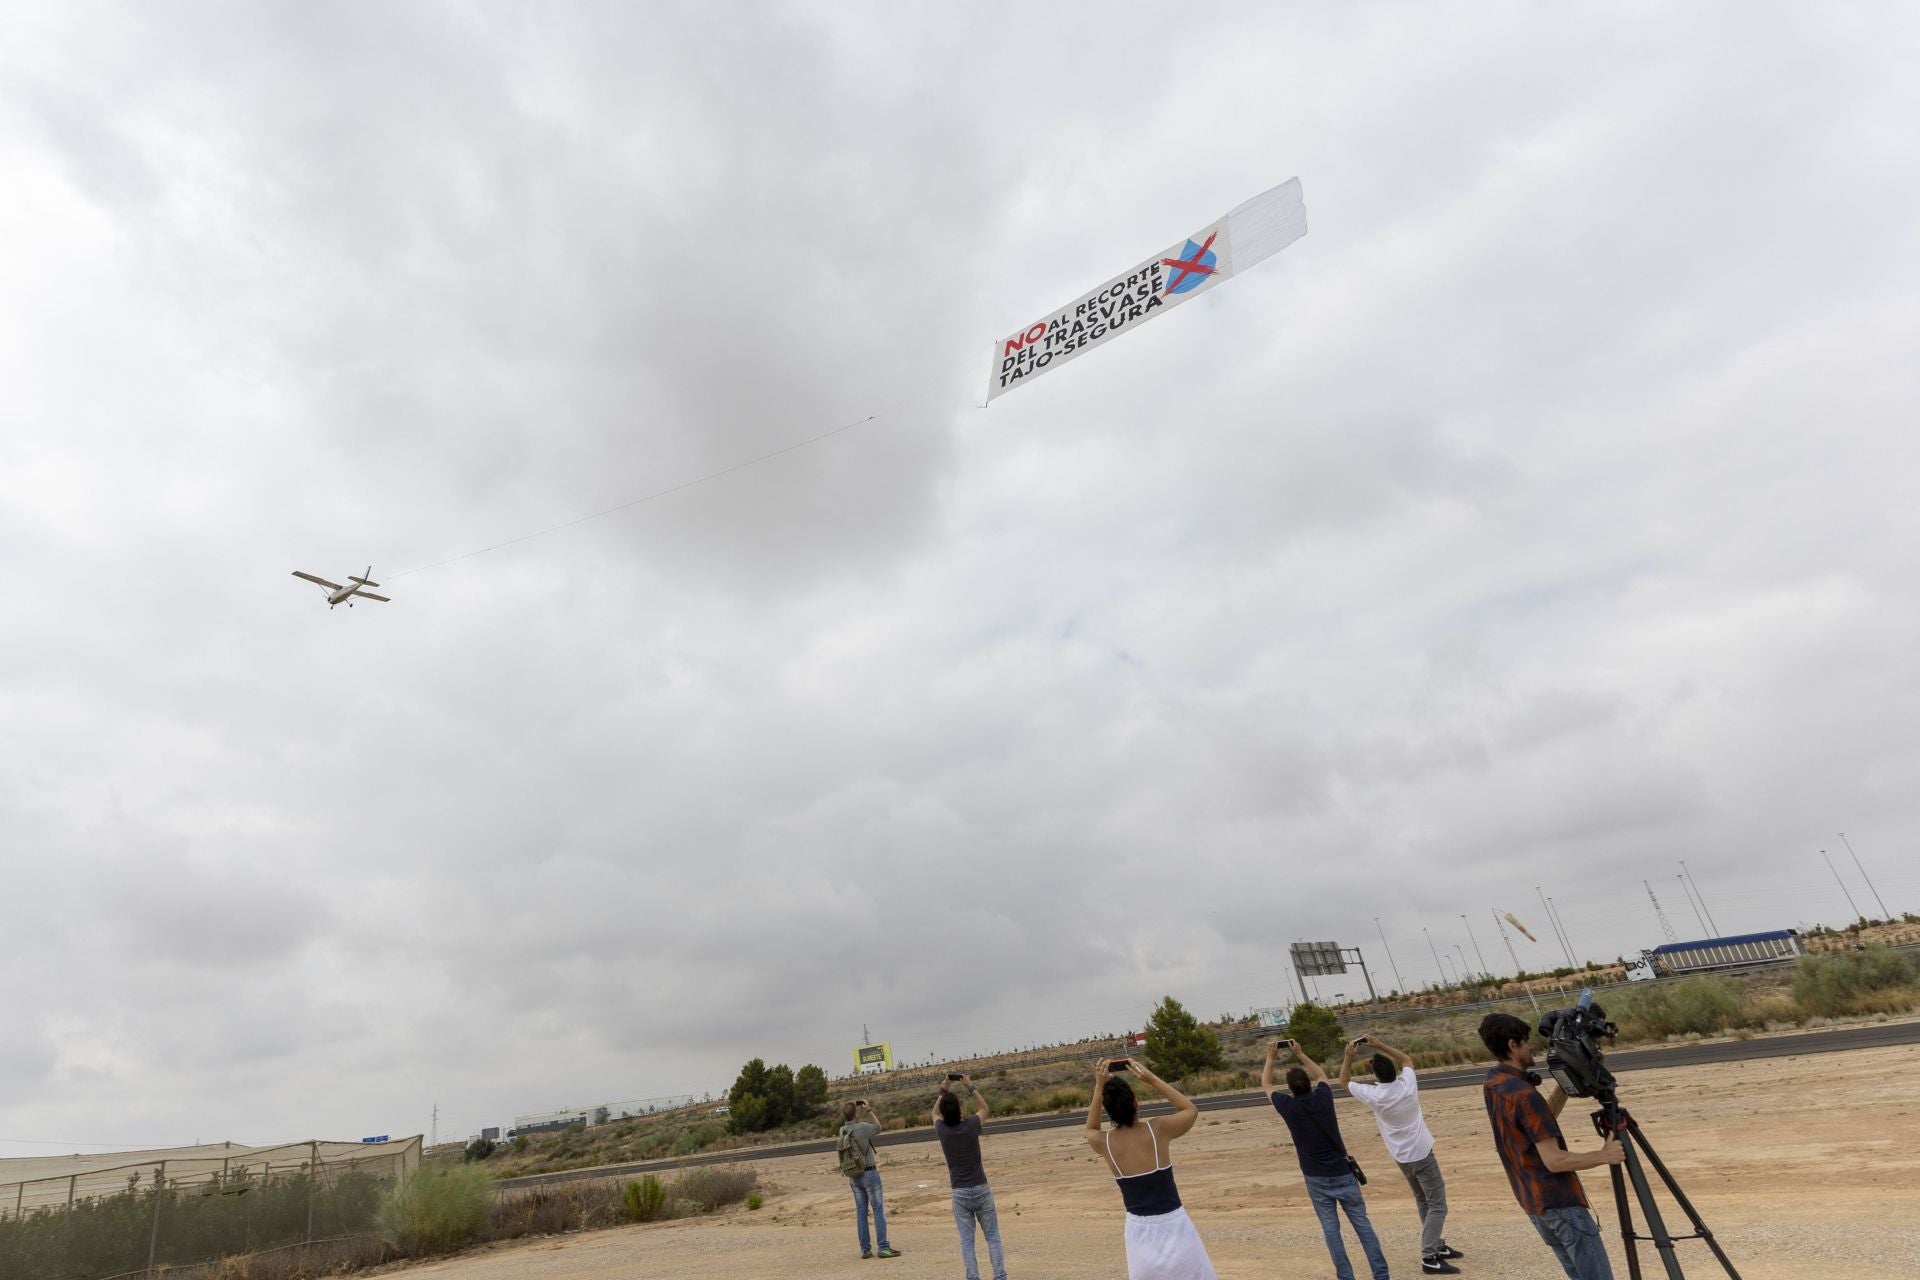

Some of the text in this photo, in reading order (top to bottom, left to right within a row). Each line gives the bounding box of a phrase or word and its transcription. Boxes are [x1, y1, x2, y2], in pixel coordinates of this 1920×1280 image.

[1000, 296, 1163, 387] TAJO-SEGURA
[1002, 276, 1162, 373] DEL TRASVASE
[1005, 261, 1159, 357] NO AL RECORTE
